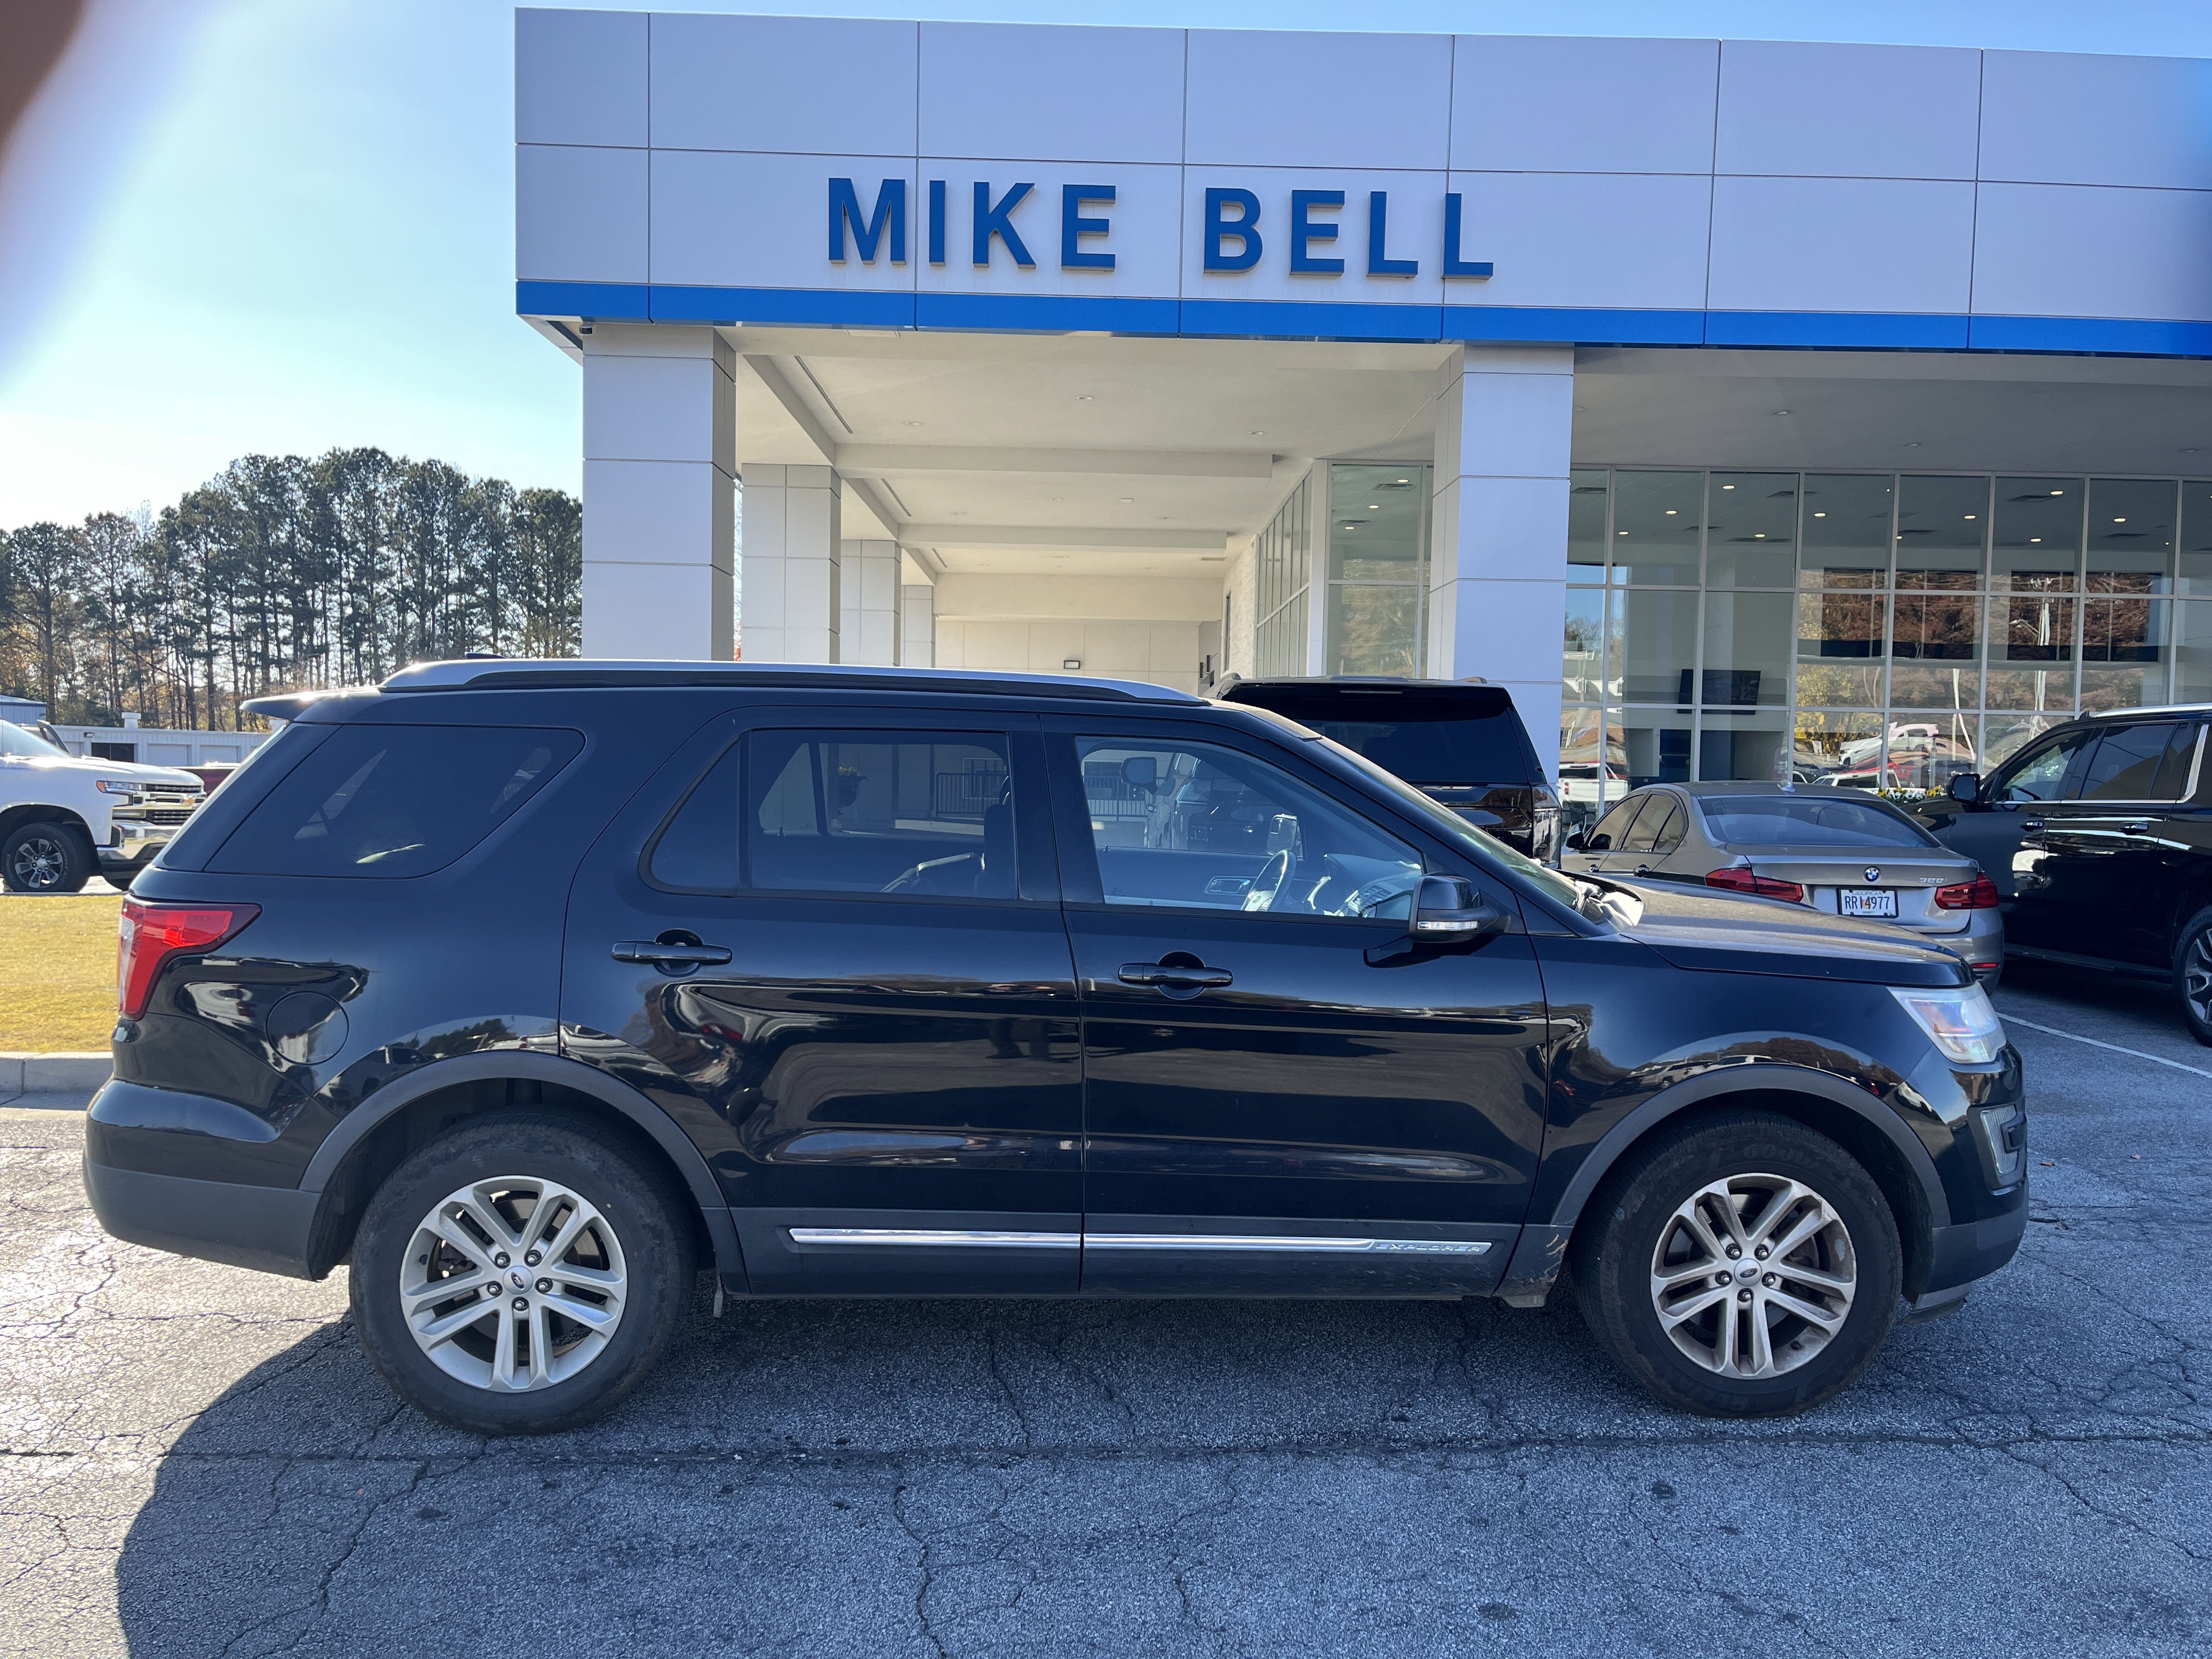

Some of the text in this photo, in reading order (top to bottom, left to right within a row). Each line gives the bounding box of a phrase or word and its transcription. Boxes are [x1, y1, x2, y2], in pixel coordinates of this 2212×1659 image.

[828, 177, 1493, 280] MIKE BELL
[1844, 895, 1890, 910] RRI4977
[1375, 1243, 1480, 1252] EXPLORER
